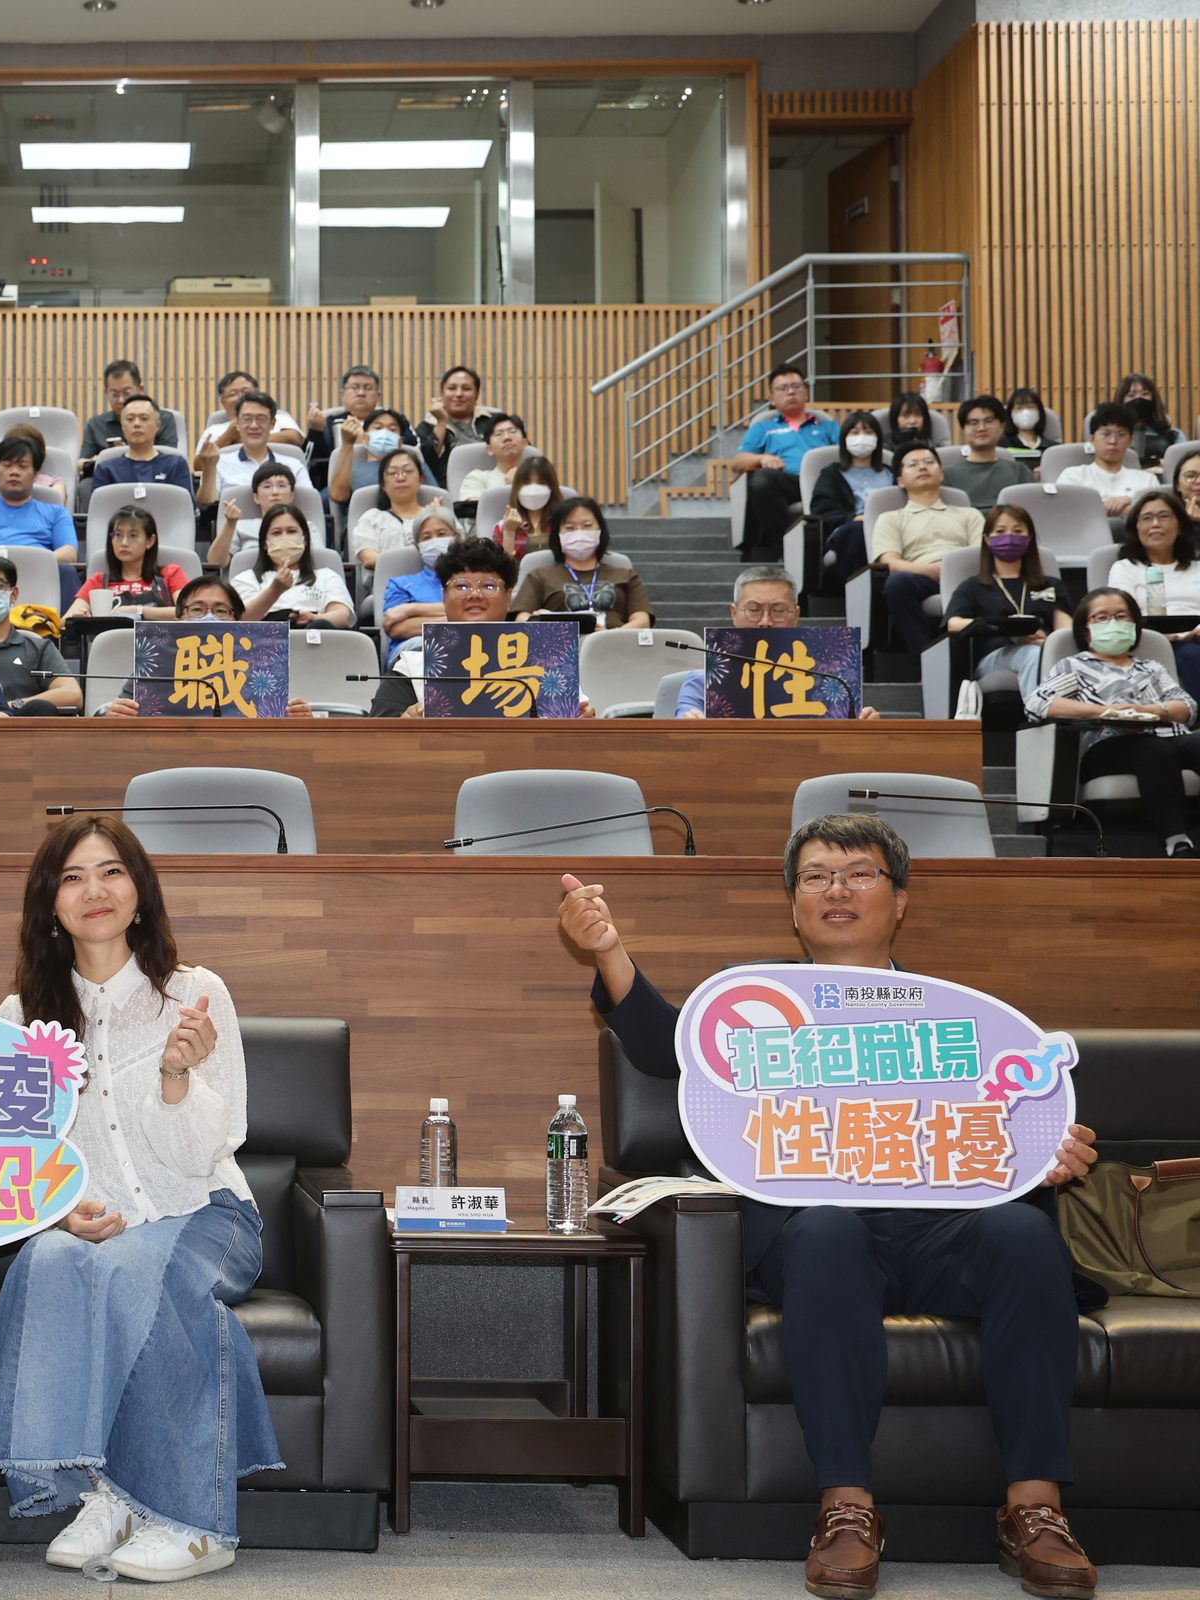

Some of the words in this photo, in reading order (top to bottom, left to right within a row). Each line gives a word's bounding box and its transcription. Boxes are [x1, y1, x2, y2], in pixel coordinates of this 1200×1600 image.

[168, 632, 257, 718] 職
[461, 632, 545, 718] 場
[740, 639, 828, 719] 性
[844, 986, 923, 1001] 南投縣政府
[730, 1019, 979, 1088] 拒絕職場
[743, 1095, 1015, 1188] 性騷擾
[450, 1195, 499, 1210] 許淑華
